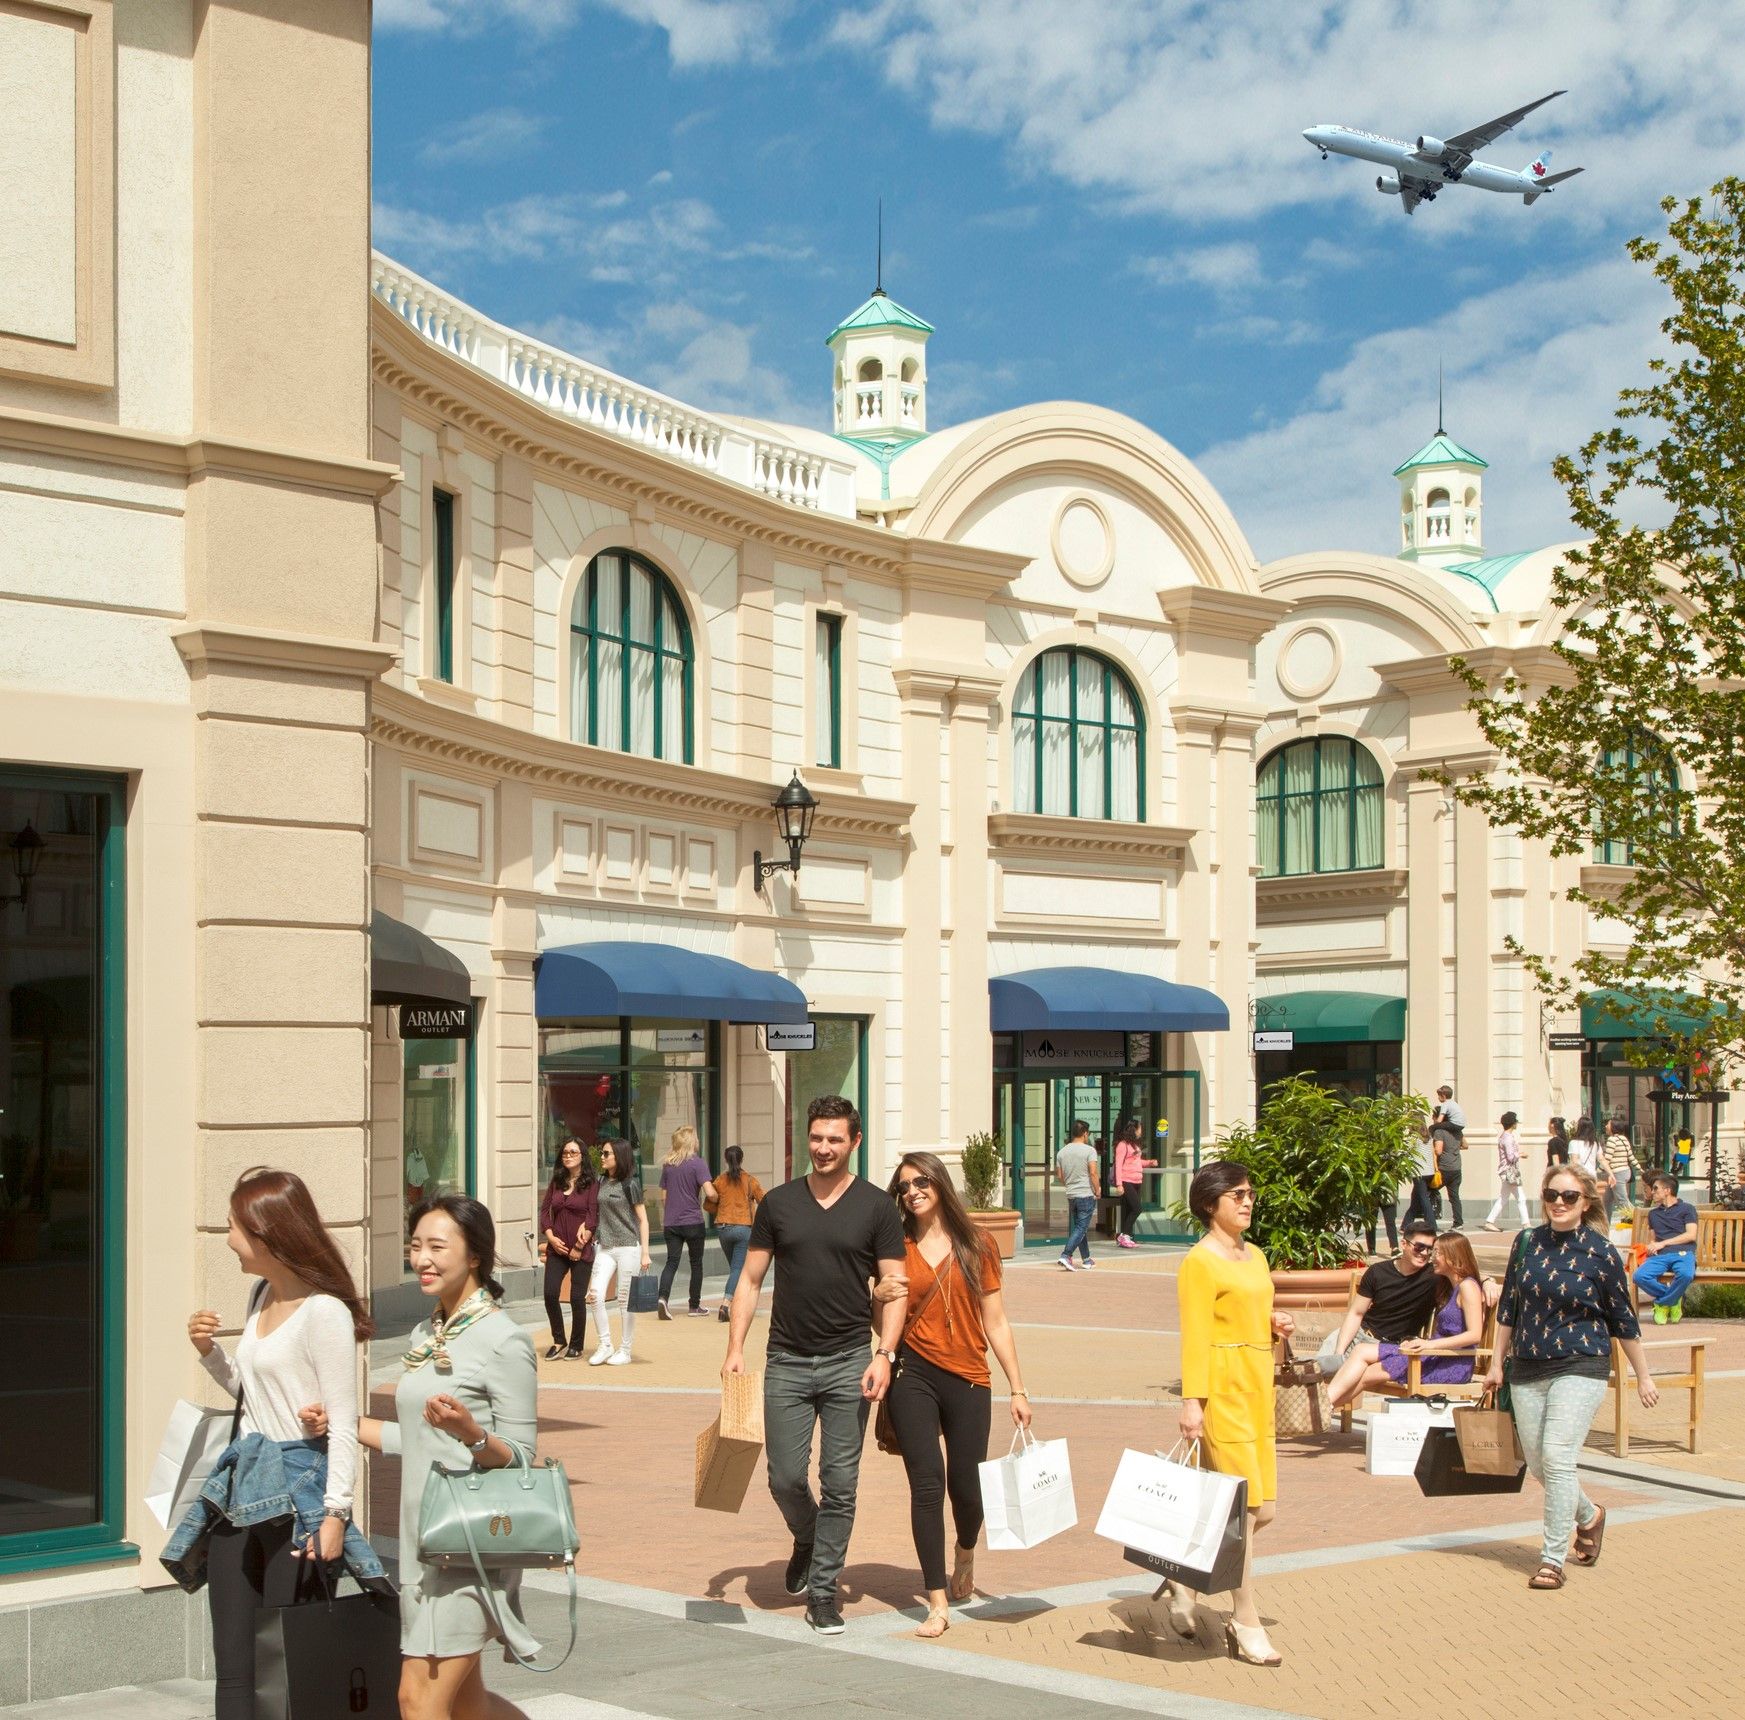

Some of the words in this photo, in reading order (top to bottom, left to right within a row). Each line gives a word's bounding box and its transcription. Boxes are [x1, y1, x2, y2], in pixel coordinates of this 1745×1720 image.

[407, 1010, 465, 1026] ARMANI
[1024, 1045, 1070, 1058] MOOSE
[1073, 1049, 1125, 1058] KNUCKLES
[1093, 1096, 1118, 1104] STRE
[1033, 1474, 1058, 1490] COACH
[1138, 1484, 1178, 1502] COACH
[1148, 1555, 1180, 1573] OUTLET
